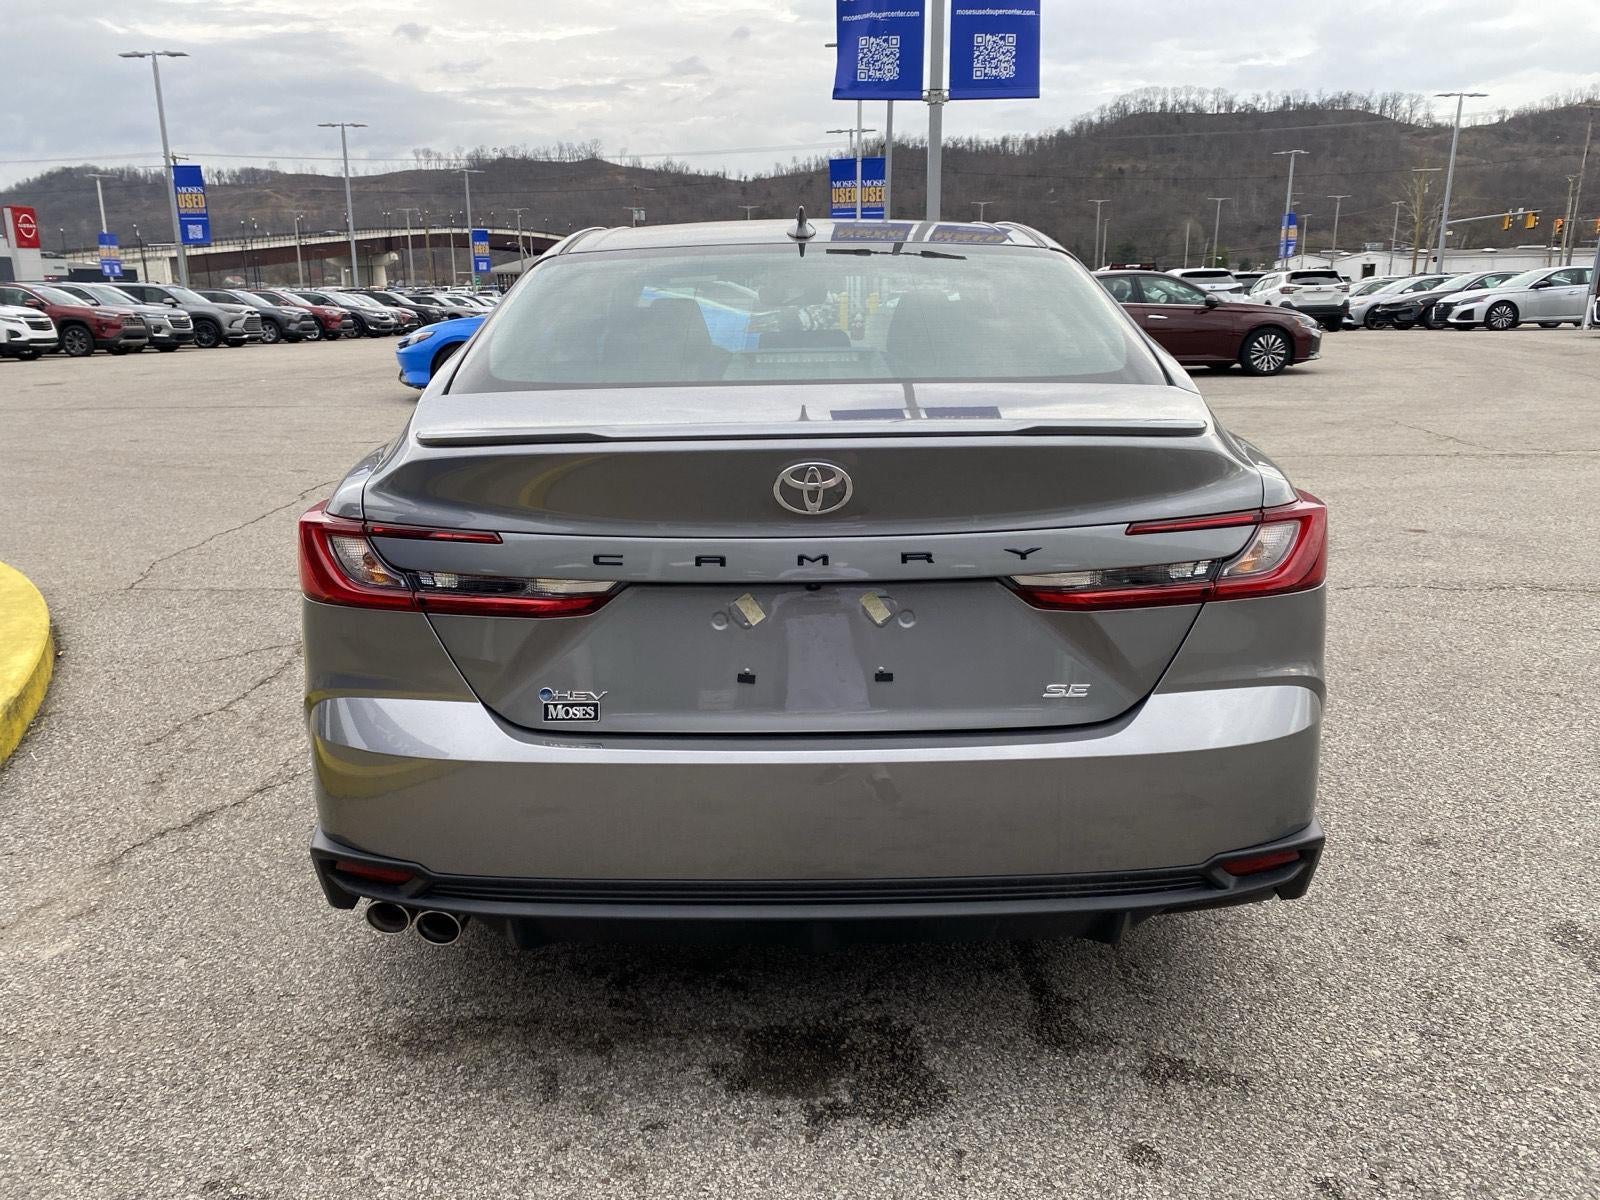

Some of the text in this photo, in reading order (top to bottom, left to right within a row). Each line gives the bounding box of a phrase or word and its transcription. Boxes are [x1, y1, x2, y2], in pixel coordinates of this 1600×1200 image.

[842, 10, 920, 22] mosesusedsupercenter.com
[956, 8, 1036, 16] mosesusedsupercenter.com
[178, 194, 206, 208] USED
[593, 547, 1042, 568] CAMRY
[1042, 683, 1091, 698] SE
